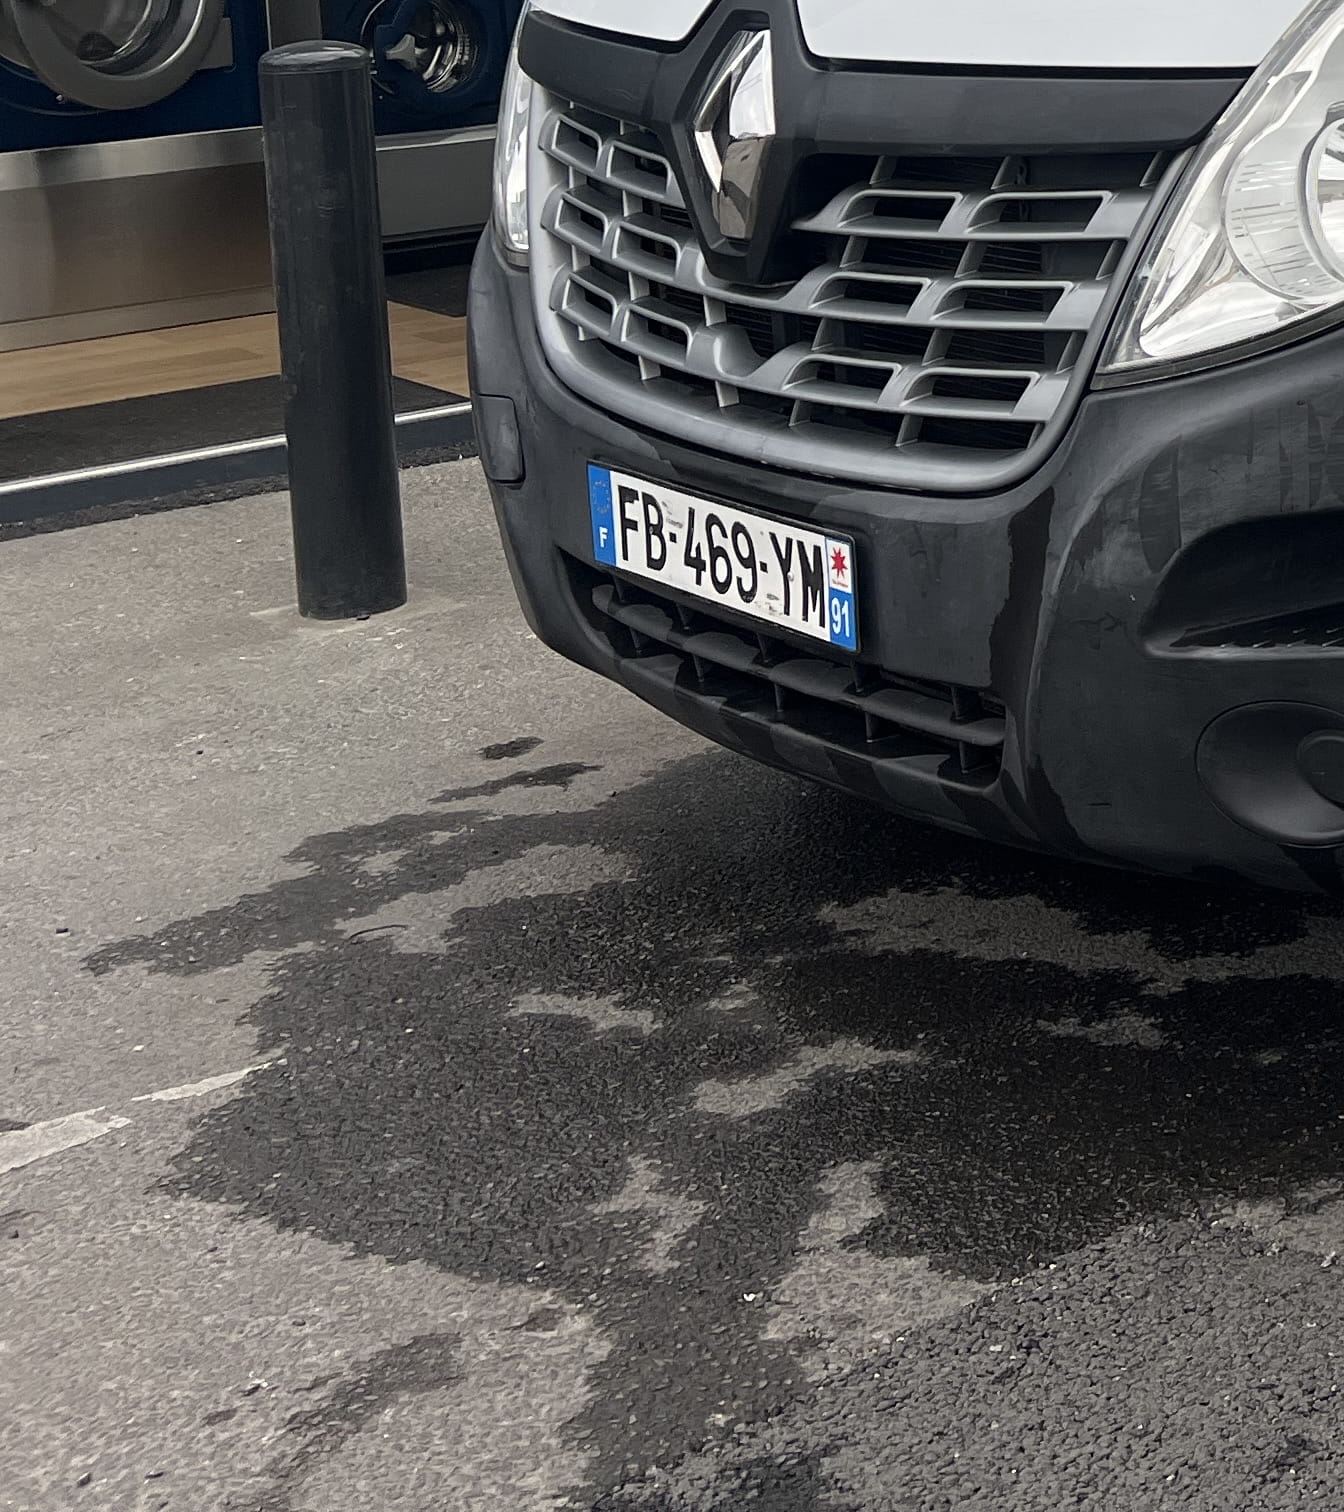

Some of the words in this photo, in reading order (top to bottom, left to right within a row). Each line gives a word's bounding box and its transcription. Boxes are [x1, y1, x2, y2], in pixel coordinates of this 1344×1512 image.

[599, 526, 609, 548] F
[616, 483, 827, 629] FB-469-YM
[831, 596, 851, 638] 91
